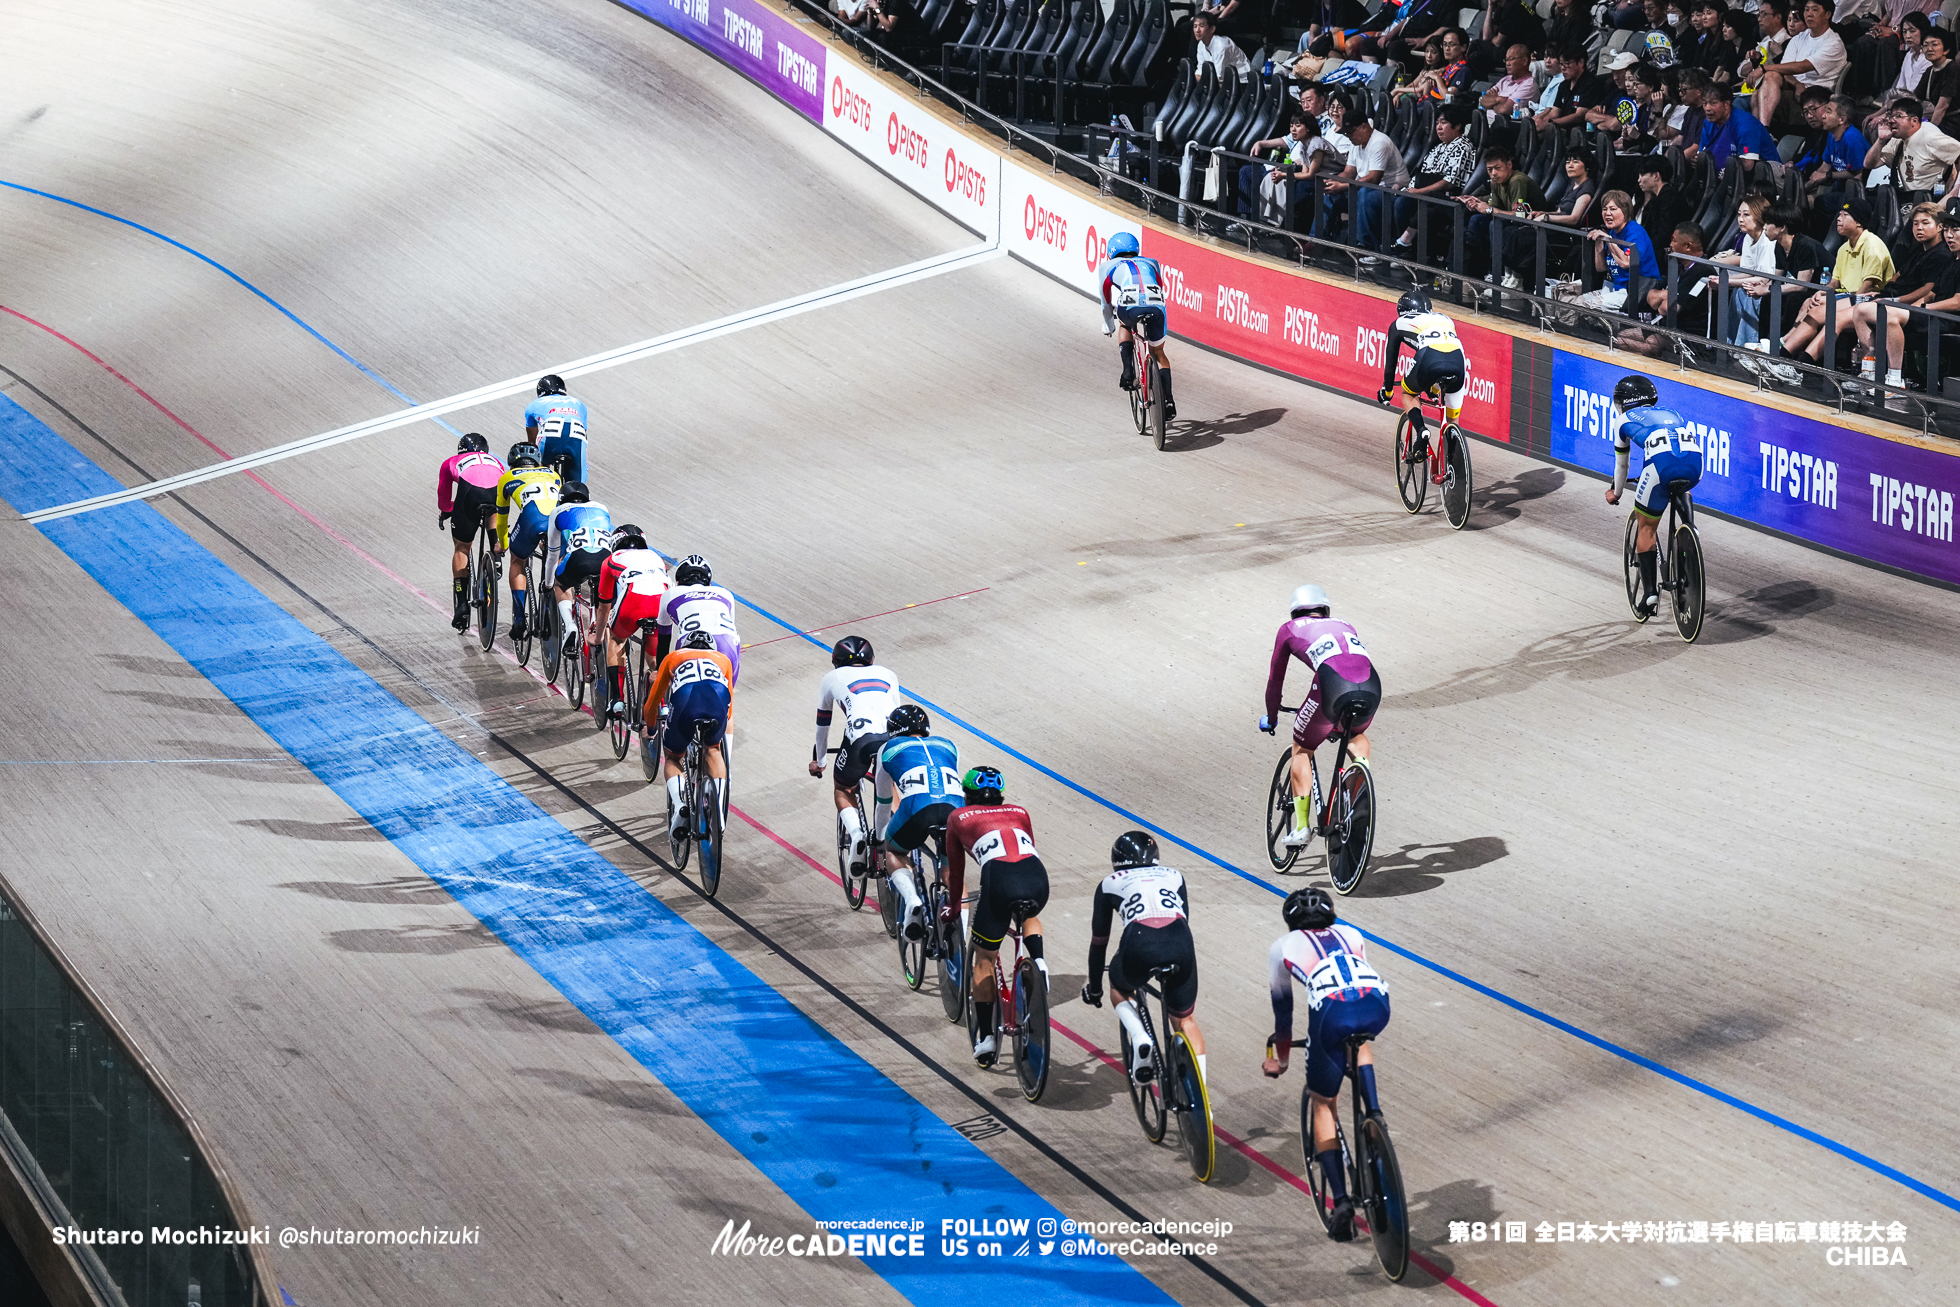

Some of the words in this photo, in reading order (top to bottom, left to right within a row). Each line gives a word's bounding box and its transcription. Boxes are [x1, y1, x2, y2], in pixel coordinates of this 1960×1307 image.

[724, 7, 763, 60] TIPSTAR
[777, 41, 817, 96] TIPSTAR
[843, 88, 871, 131] PIST6
[899, 124, 928, 168] PIST6
[957, 161, 986, 206] PIST6
[1037, 207, 1067, 251] PIST6
[1216, 285, 1268, 334] PIST6.com
[1284, 305, 1339, 356] PIST6.com
[1760, 442, 1838, 510] TIPSTAR
[1869, 473, 1953, 542] TIPSTAR
[1294, 697, 1320, 734] WASEDA
[836, 748, 848, 771] KEIO
[958, 807, 1026, 821] RITSUMEIKAN
